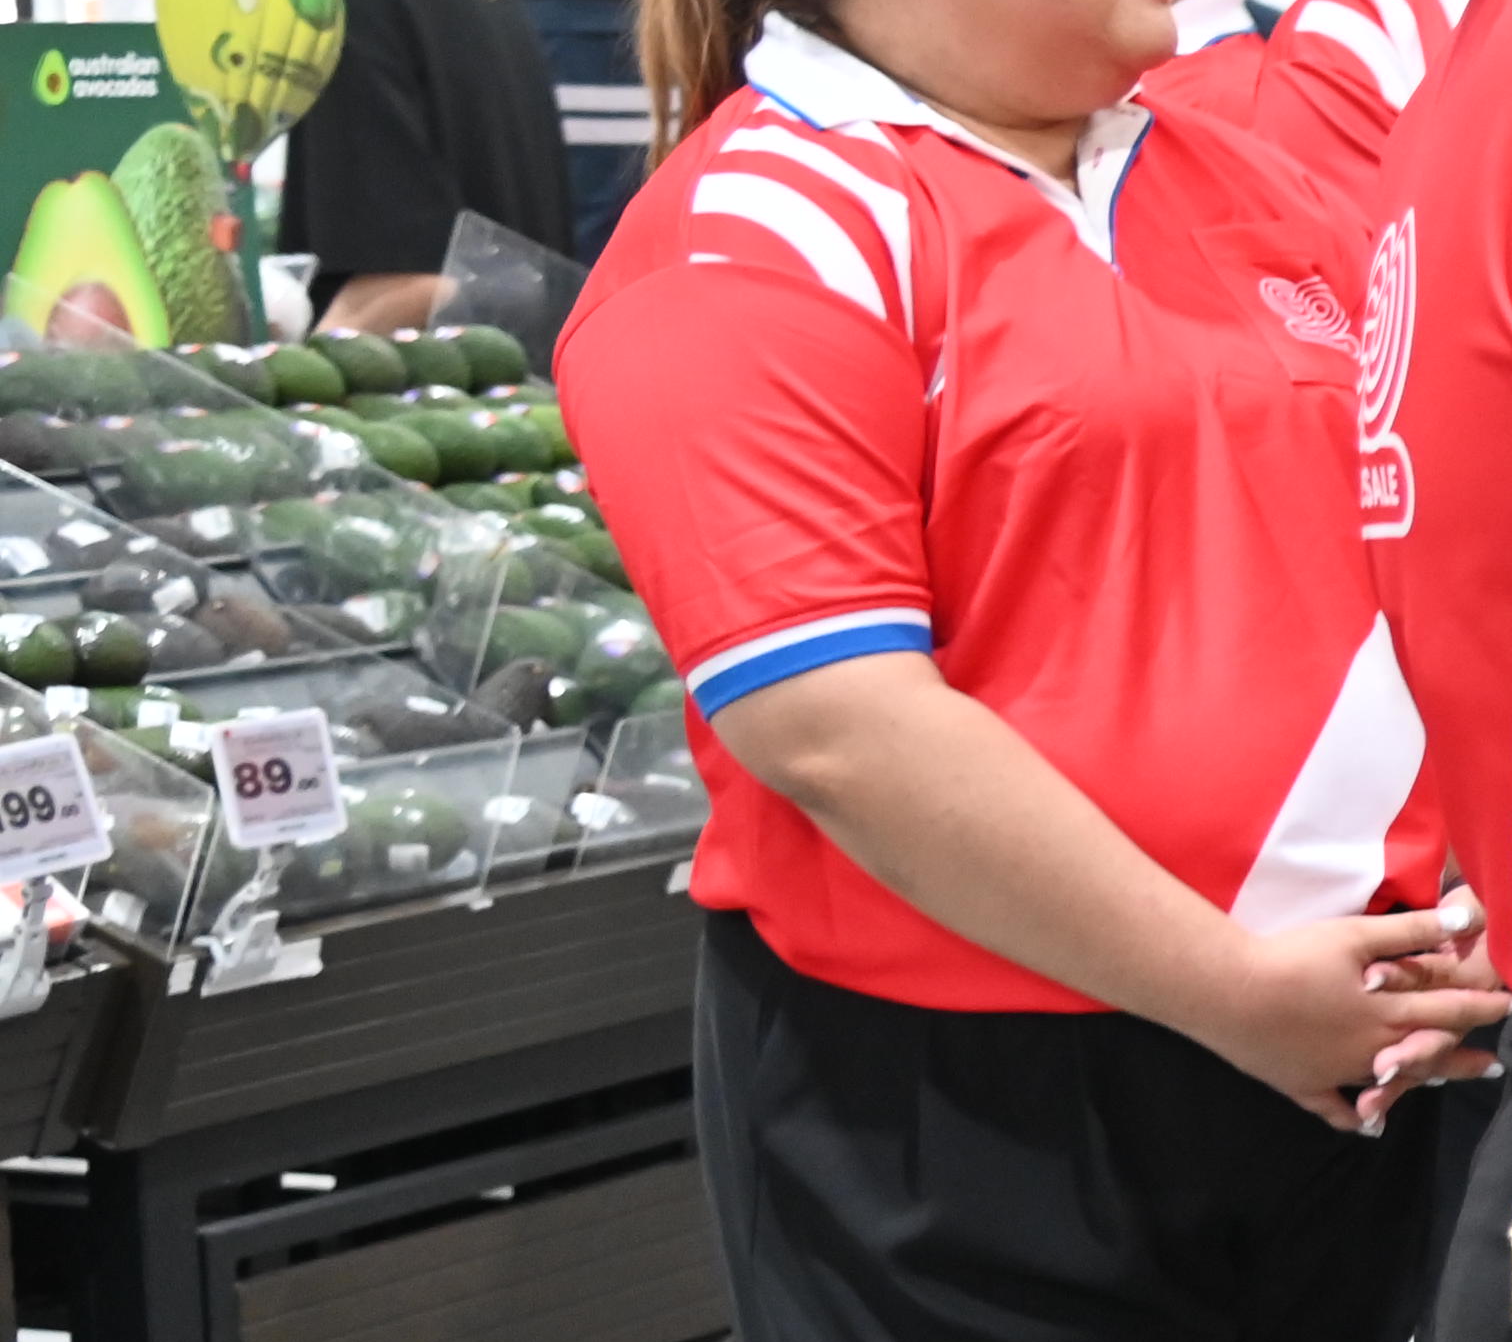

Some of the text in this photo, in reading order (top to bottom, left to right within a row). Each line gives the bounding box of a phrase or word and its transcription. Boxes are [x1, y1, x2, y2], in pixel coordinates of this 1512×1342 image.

[69, 50, 160, 76] australian
[73, 76, 158, 98] avocados
[0, 785, 80, 834] 99.00
